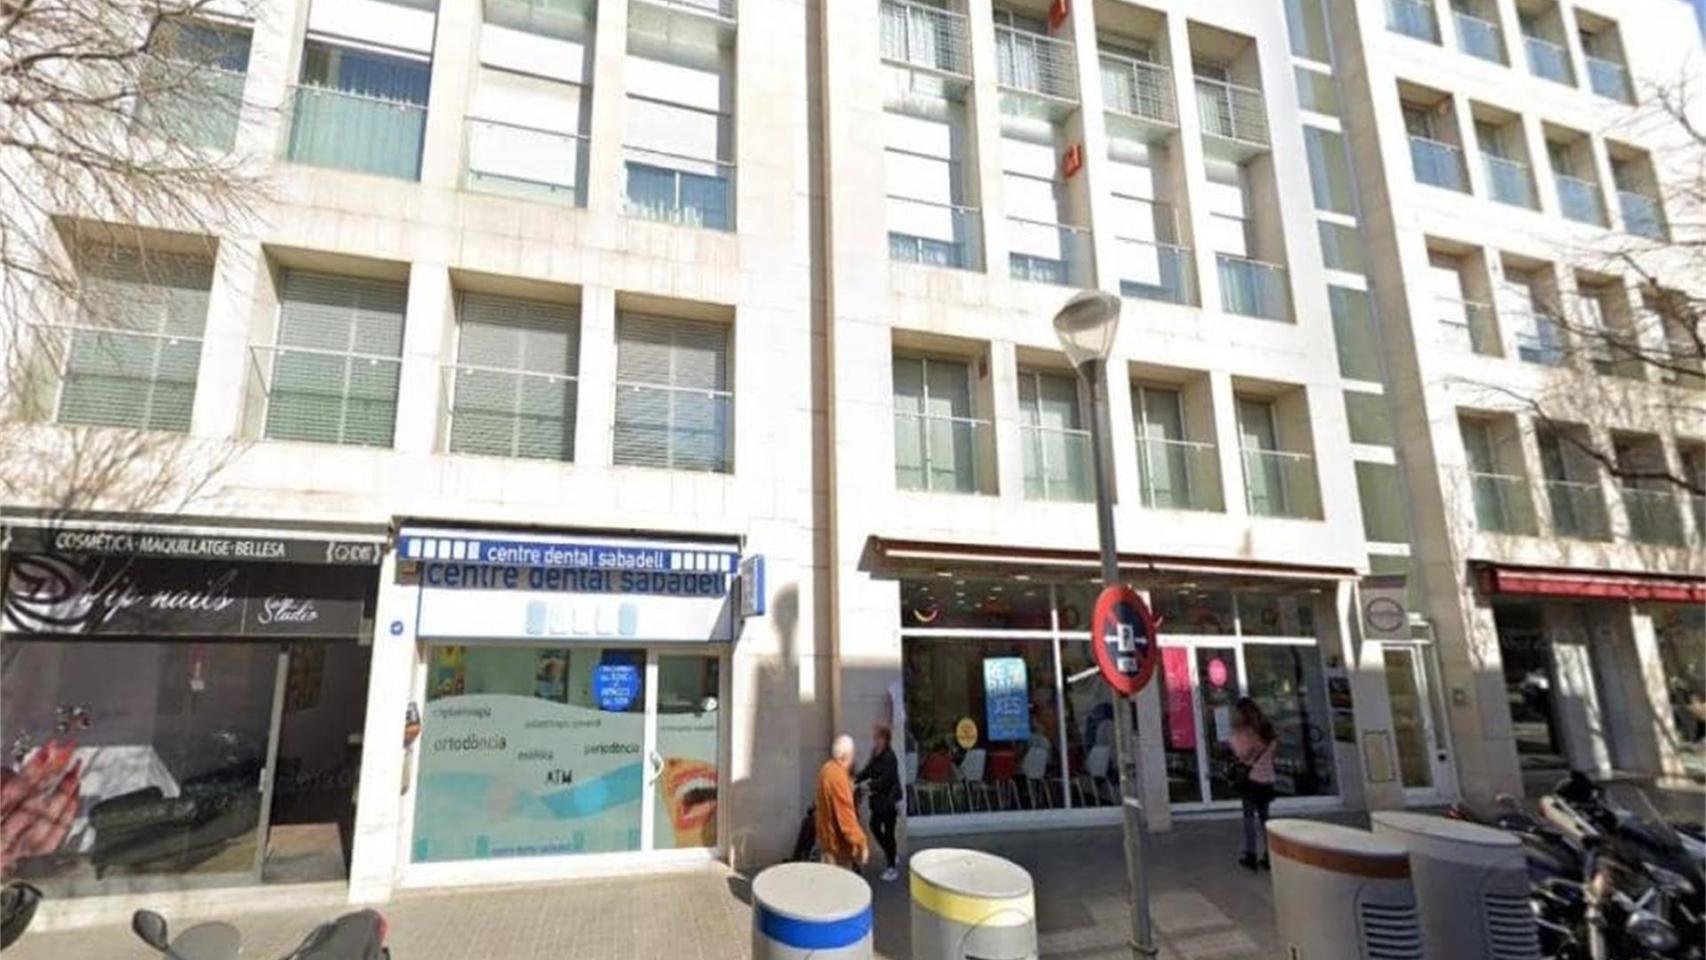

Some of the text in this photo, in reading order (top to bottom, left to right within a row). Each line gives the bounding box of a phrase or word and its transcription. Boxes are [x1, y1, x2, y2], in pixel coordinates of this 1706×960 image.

[487, 545, 664, 569] centre dental sabadell
[427, 562, 519, 588] centre
[529, 566, 611, 592] dental
